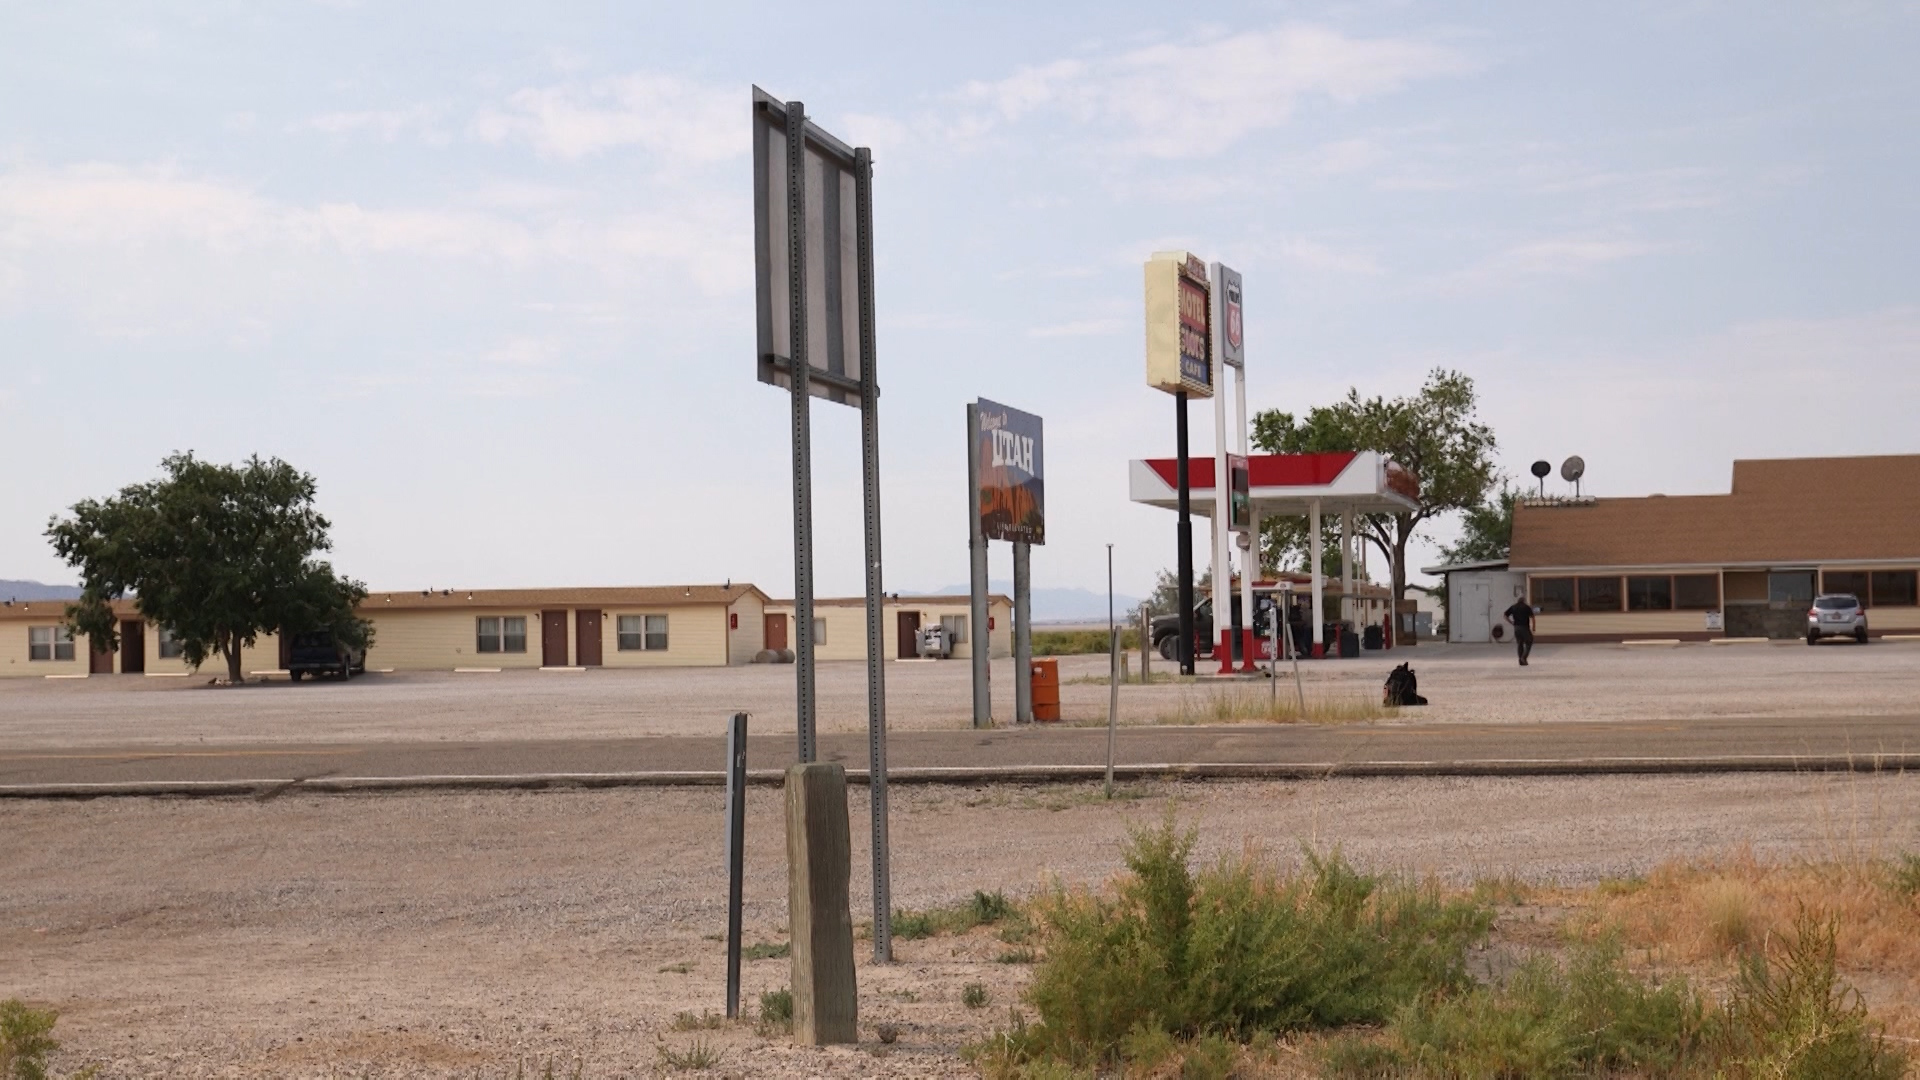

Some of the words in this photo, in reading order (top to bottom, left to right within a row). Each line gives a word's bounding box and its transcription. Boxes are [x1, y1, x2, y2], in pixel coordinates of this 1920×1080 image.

[1180, 286, 1206, 326] MOTEL
[1231, 309, 1241, 336] 66
[991, 429, 1035, 477] UTAH
